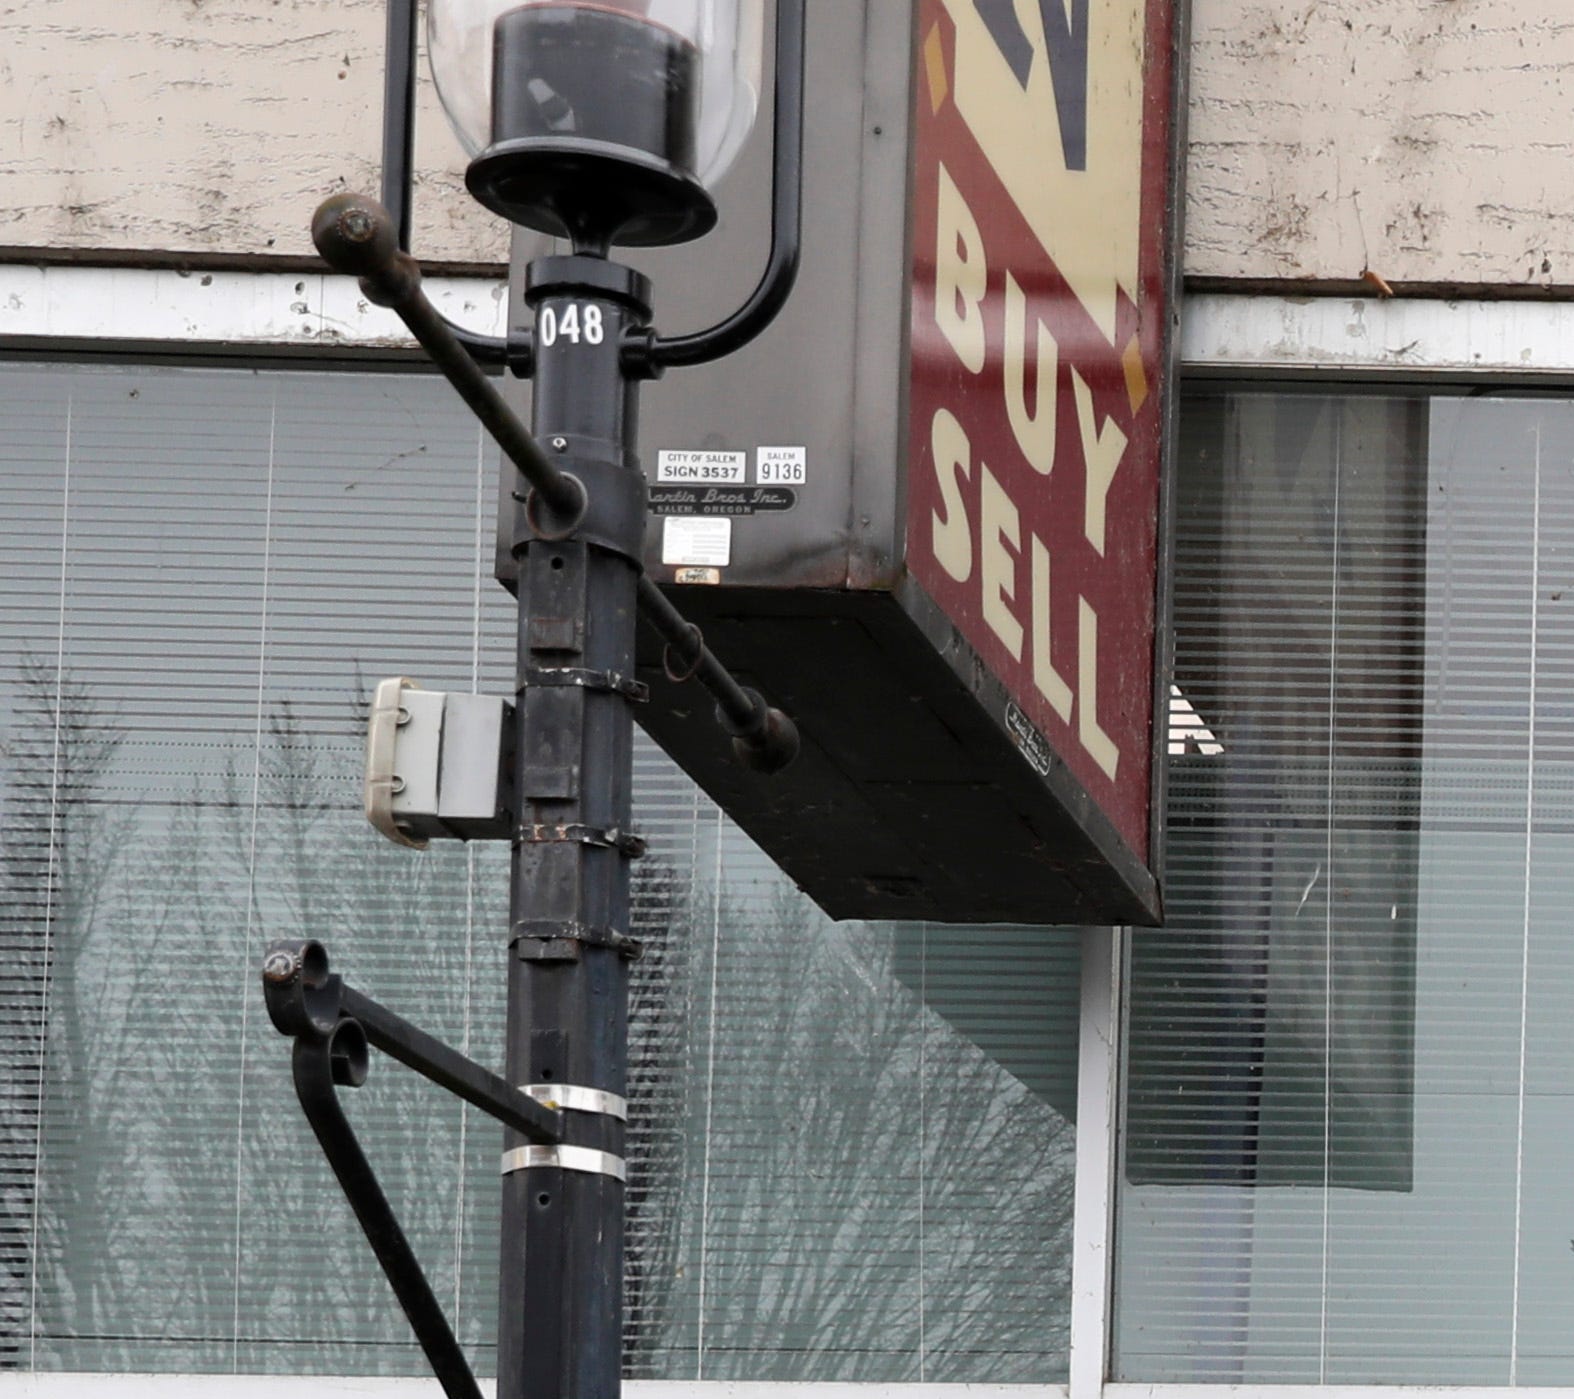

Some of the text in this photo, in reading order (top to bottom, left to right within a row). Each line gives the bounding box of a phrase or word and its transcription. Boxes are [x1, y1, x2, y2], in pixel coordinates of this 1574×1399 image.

[540, 304, 604, 346] 048
[935, 160, 1128, 558] BUY
[664, 466, 739, 479] SIGN 3537
[706, 454, 736, 463] SALEM
[761, 463, 803, 480] 9136
[931, 407, 1120, 782] SELL
